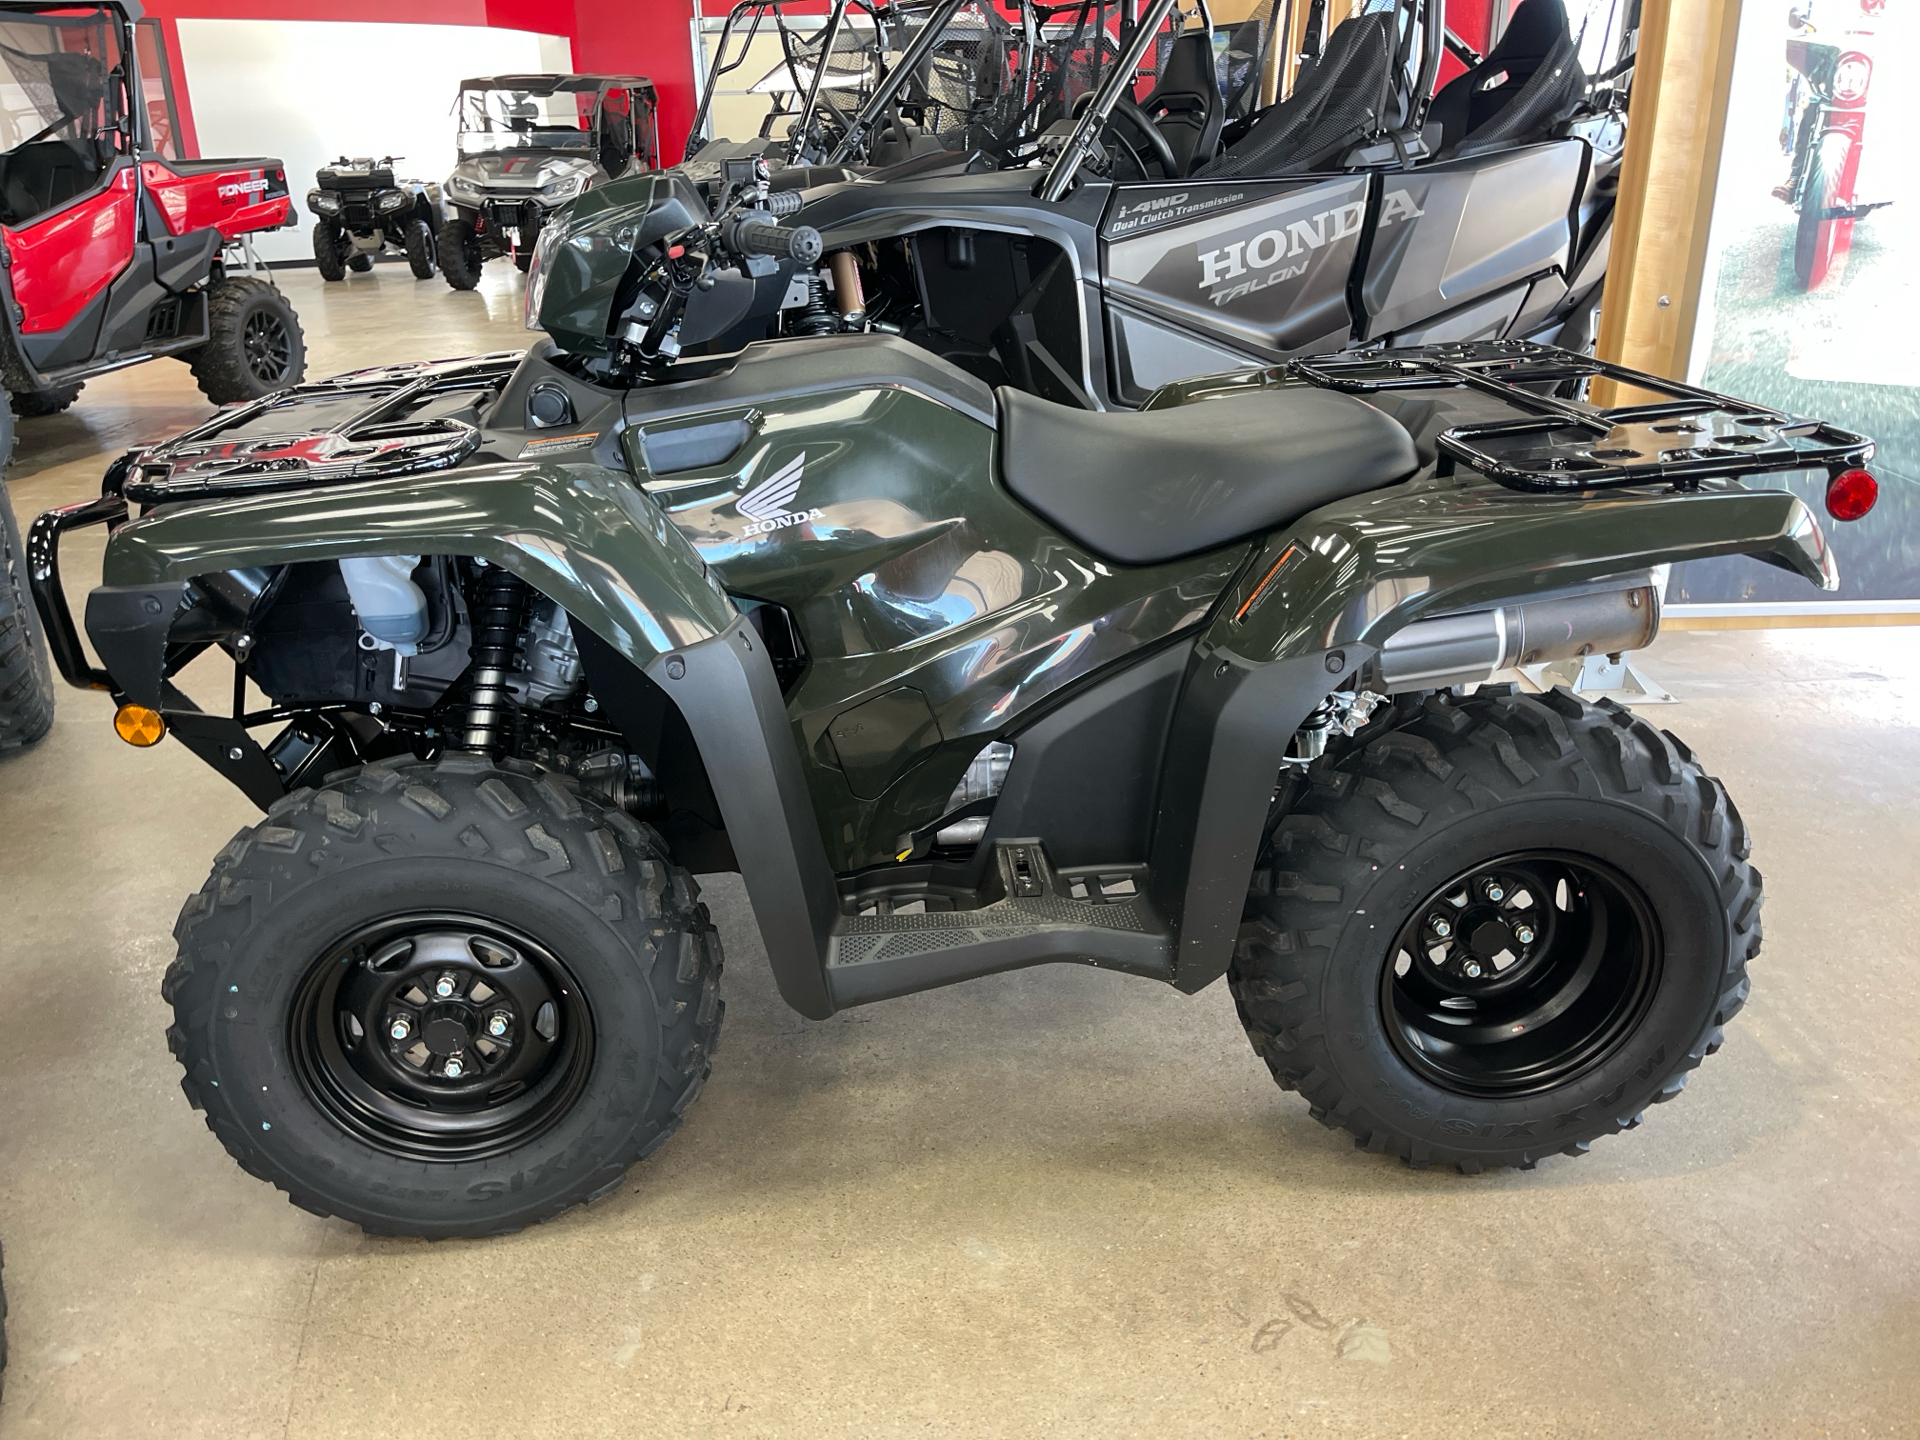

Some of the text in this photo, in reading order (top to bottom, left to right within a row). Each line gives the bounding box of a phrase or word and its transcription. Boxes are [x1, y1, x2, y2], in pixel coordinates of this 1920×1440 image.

[217, 179, 269, 198] PIONEER
[1118, 193, 1189, 219] i-4WD
[1112, 193, 1244, 233] Dual Clutch Transmission
[1197, 189, 1425, 289] HONDA
[1208, 260, 1309, 307] TALON
[741, 508, 826, 537] HONDA
[1441, 1041, 1667, 1140] MAXXIS
